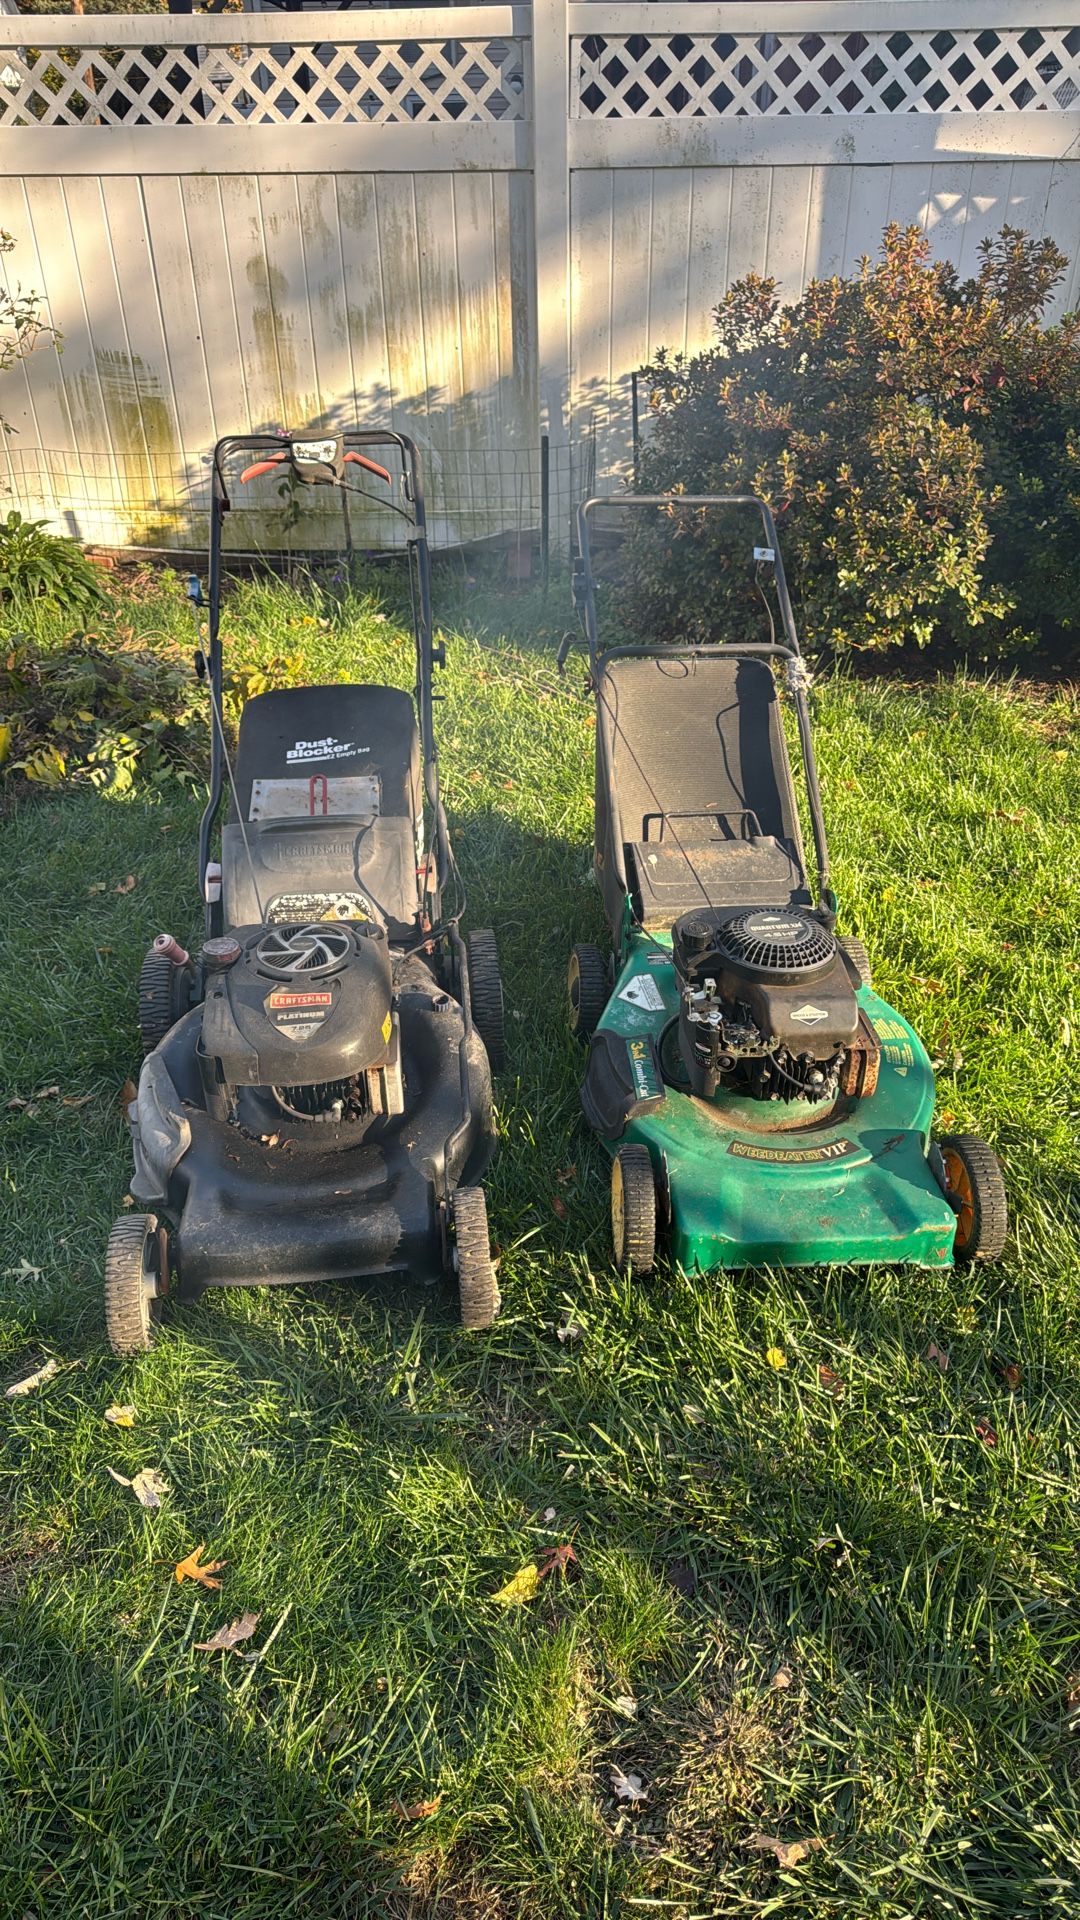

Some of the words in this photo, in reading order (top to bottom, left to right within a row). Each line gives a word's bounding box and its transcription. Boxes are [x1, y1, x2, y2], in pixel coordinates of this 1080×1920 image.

[295, 737, 338, 750] Dust-
[286, 743, 351, 759] Blocker
[336, 750, 357, 759] Empty
[358, 746, 371, 754] Bag
[273, 994, 329, 1006] CRAFTSMAN
[276, 1010, 325, 1021] PLATINUM
[822, 1141, 847, 1158] VIP
